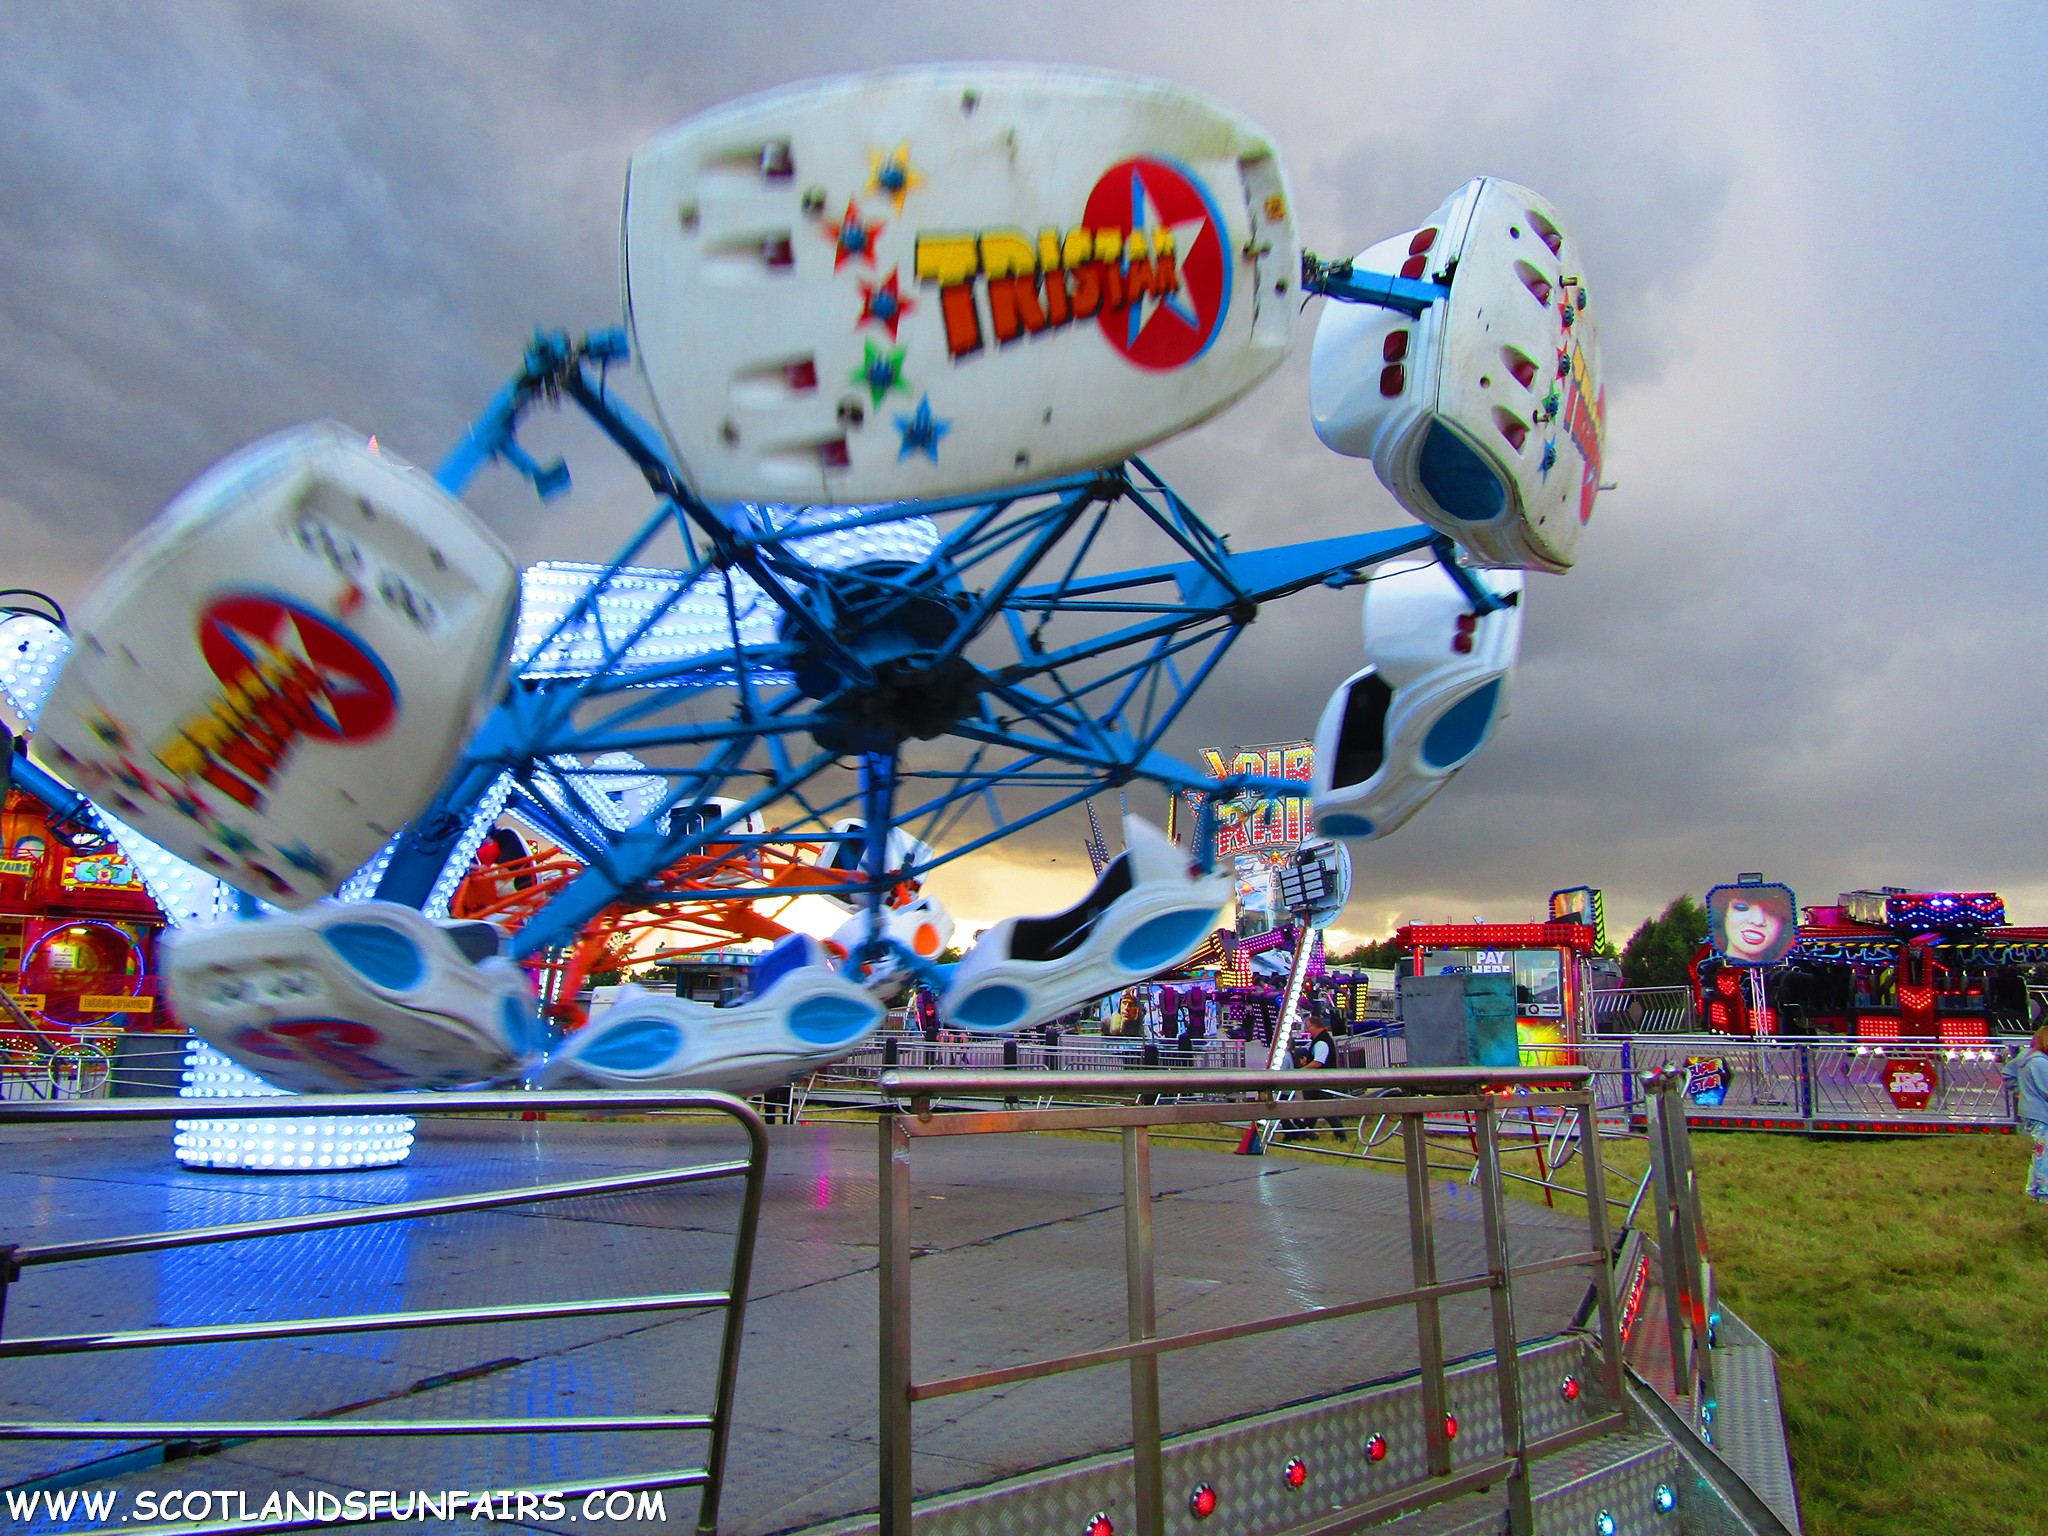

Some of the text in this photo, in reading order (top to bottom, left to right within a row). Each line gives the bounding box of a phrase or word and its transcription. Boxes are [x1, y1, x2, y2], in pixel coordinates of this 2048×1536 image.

[915, 227, 1178, 356] TRISTAR
[1476, 951, 1506, 964] PAY
[1892, 1072, 1924, 1083] TOP
[1889, 1081, 1930, 1093] STAR
